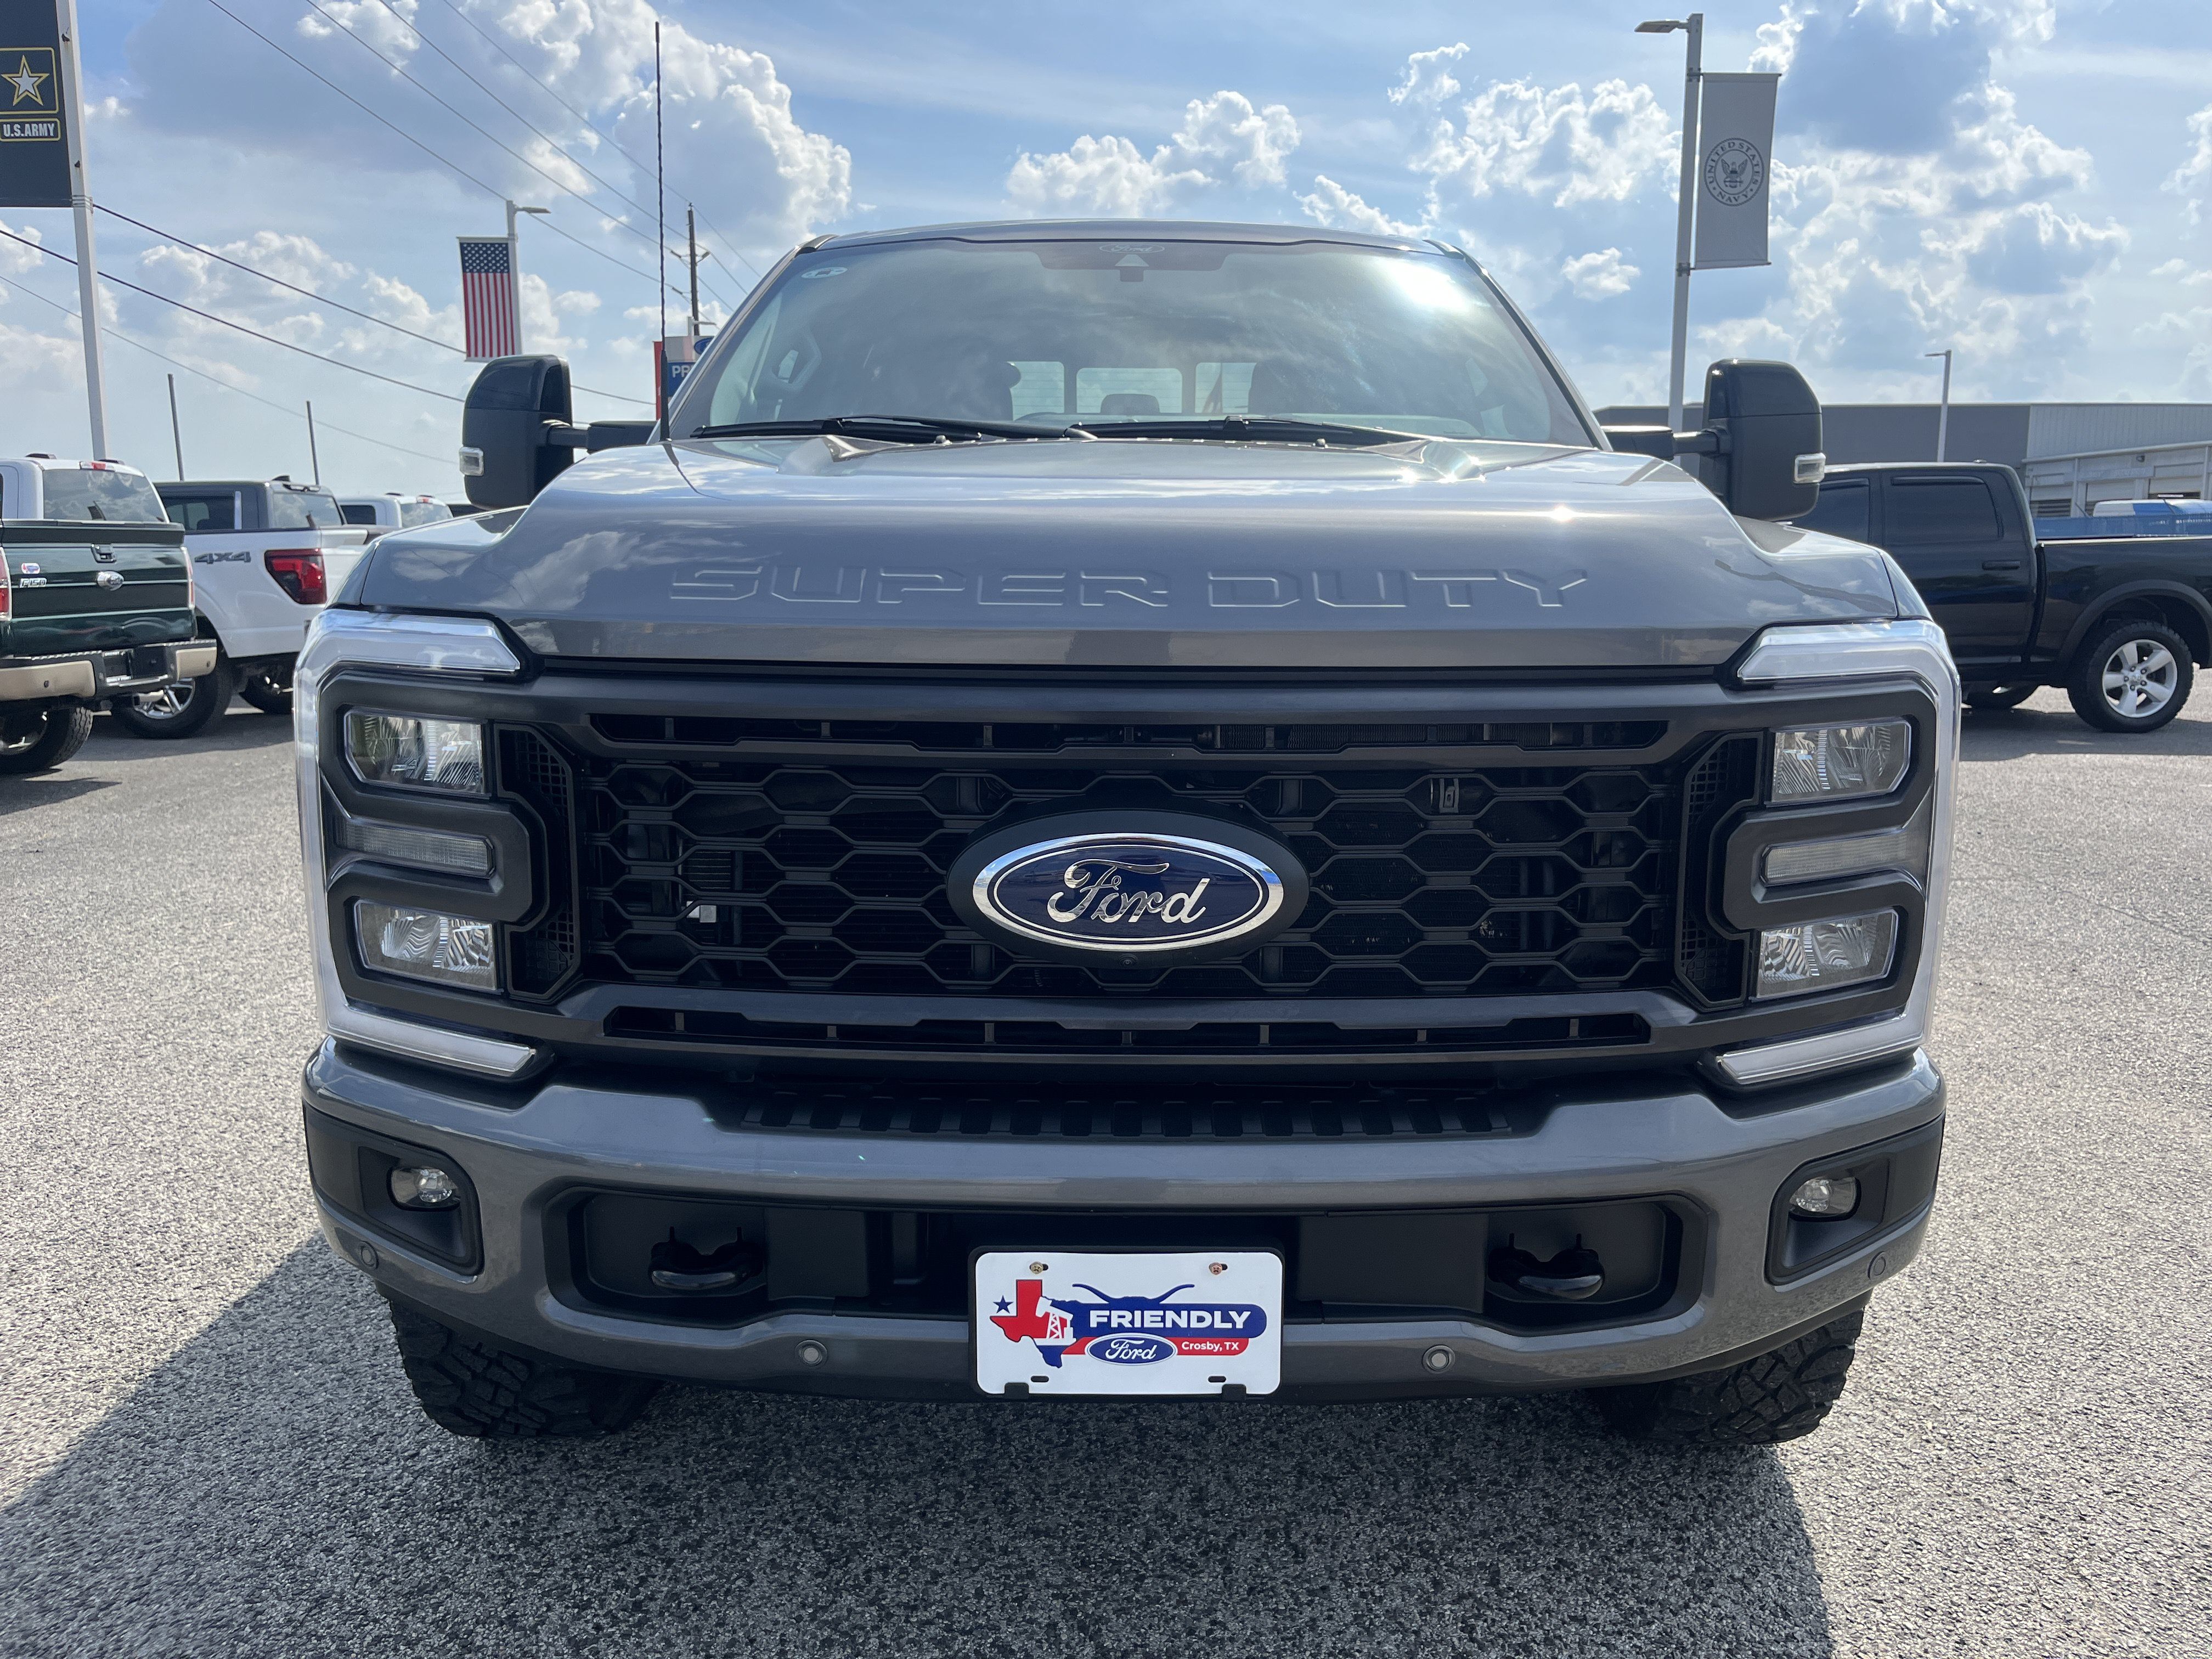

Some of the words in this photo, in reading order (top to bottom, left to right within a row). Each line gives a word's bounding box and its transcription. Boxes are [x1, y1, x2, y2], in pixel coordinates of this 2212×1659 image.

[1707, 142, 1735, 184] UNITED
[1738, 142, 1760, 185] STATES
[1717, 190, 1749, 203] NAVY
[670, 566, 1170, 607] SUPER
[1208, 568, 1587, 608] DUTY
[1047, 858, 1210, 923] Ford
[1090, 1310, 1251, 1329] FRIENDLY
[1105, 1339, 1158, 1360] Ford
[1181, 1341, 1222, 1352] Crosby,
[1224, 1341, 1239, 1351] TX
